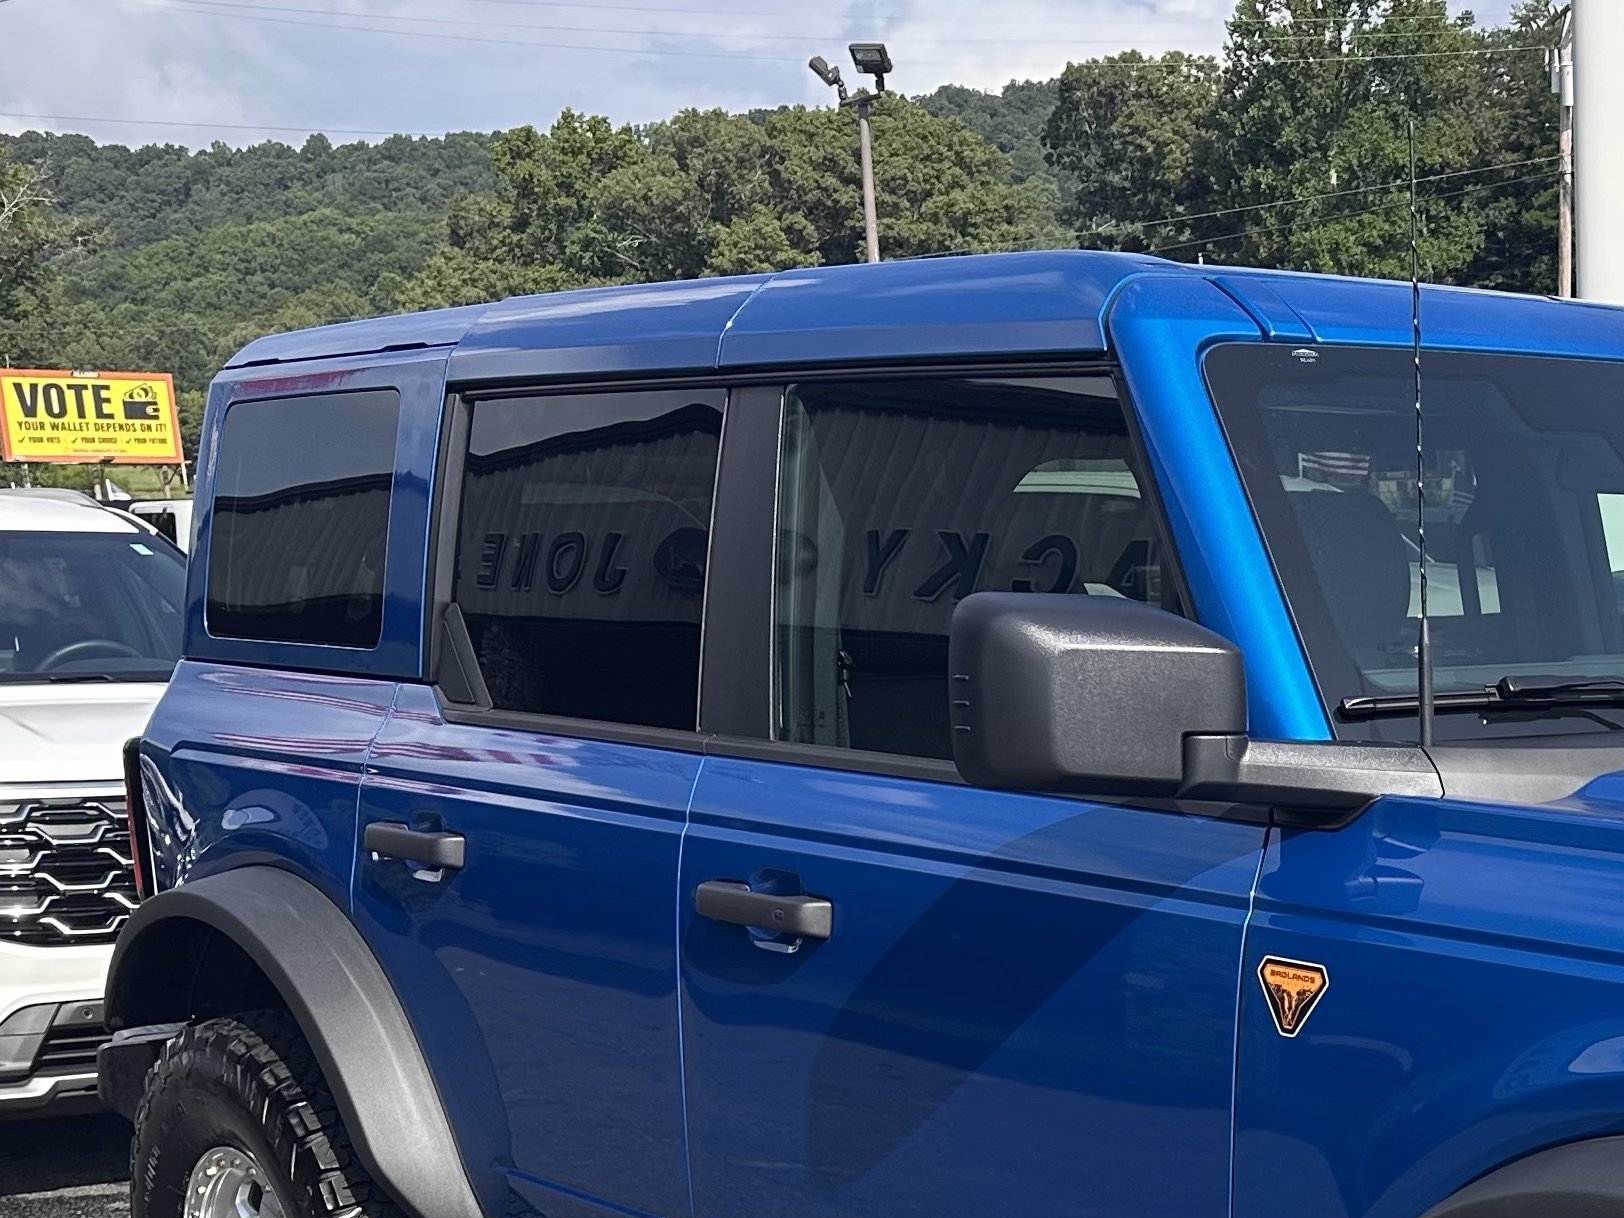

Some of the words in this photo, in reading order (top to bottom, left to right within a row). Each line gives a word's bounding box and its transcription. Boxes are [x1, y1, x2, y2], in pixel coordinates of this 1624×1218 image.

[12, 382, 115, 420] VOTE
[17, 421, 46, 432] YOUR
[49, 421, 90, 432] WALLET
[94, 422, 137, 433] DEPENDS
[140, 422, 153, 433] ON
[155, 423, 167, 433] IT!
[1270, 968, 1316, 984] BADLANDS
